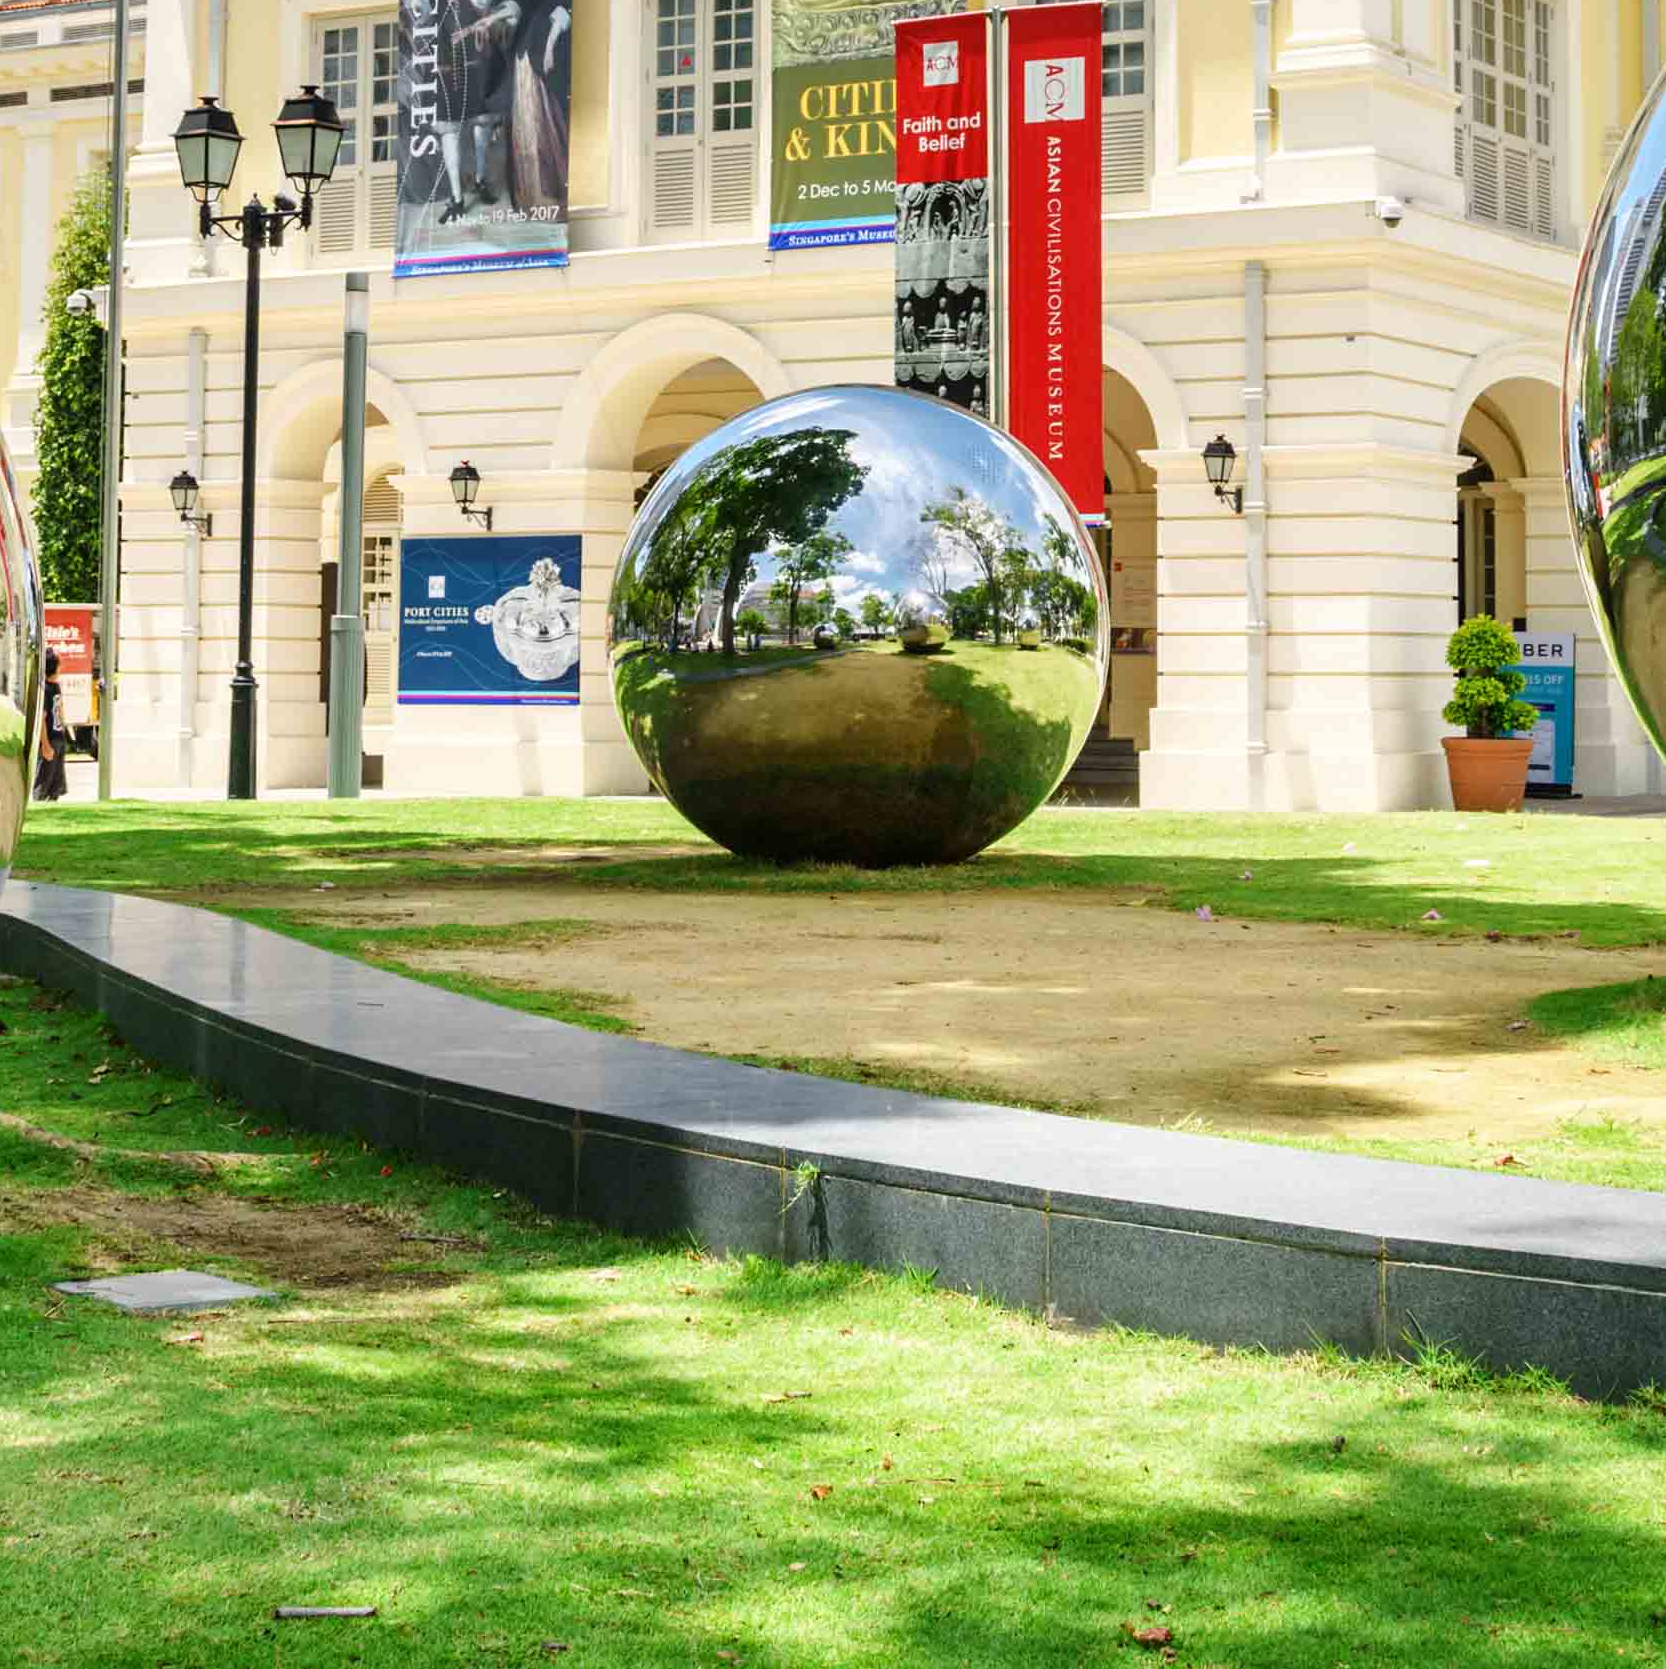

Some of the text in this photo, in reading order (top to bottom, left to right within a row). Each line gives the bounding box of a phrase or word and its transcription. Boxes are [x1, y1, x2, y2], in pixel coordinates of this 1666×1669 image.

[902, 111, 981, 135] Faith and
[785, 127, 811, 162] &
[918, 133, 965, 153] Belief
[797, 184, 807, 200] 2
[810, 183, 840, 199] Dec
[843, 181, 859, 195] to
[861, 179, 871, 194] 5
[493, 210, 502, 222] 19
[507, 208, 526, 221] Feb
[531, 205, 560, 221] 2017
[1046, 136, 1064, 460] ASIAN CIVILISATIONS MUSEUM
[405, 606, 469, 617] PORT CITIES
